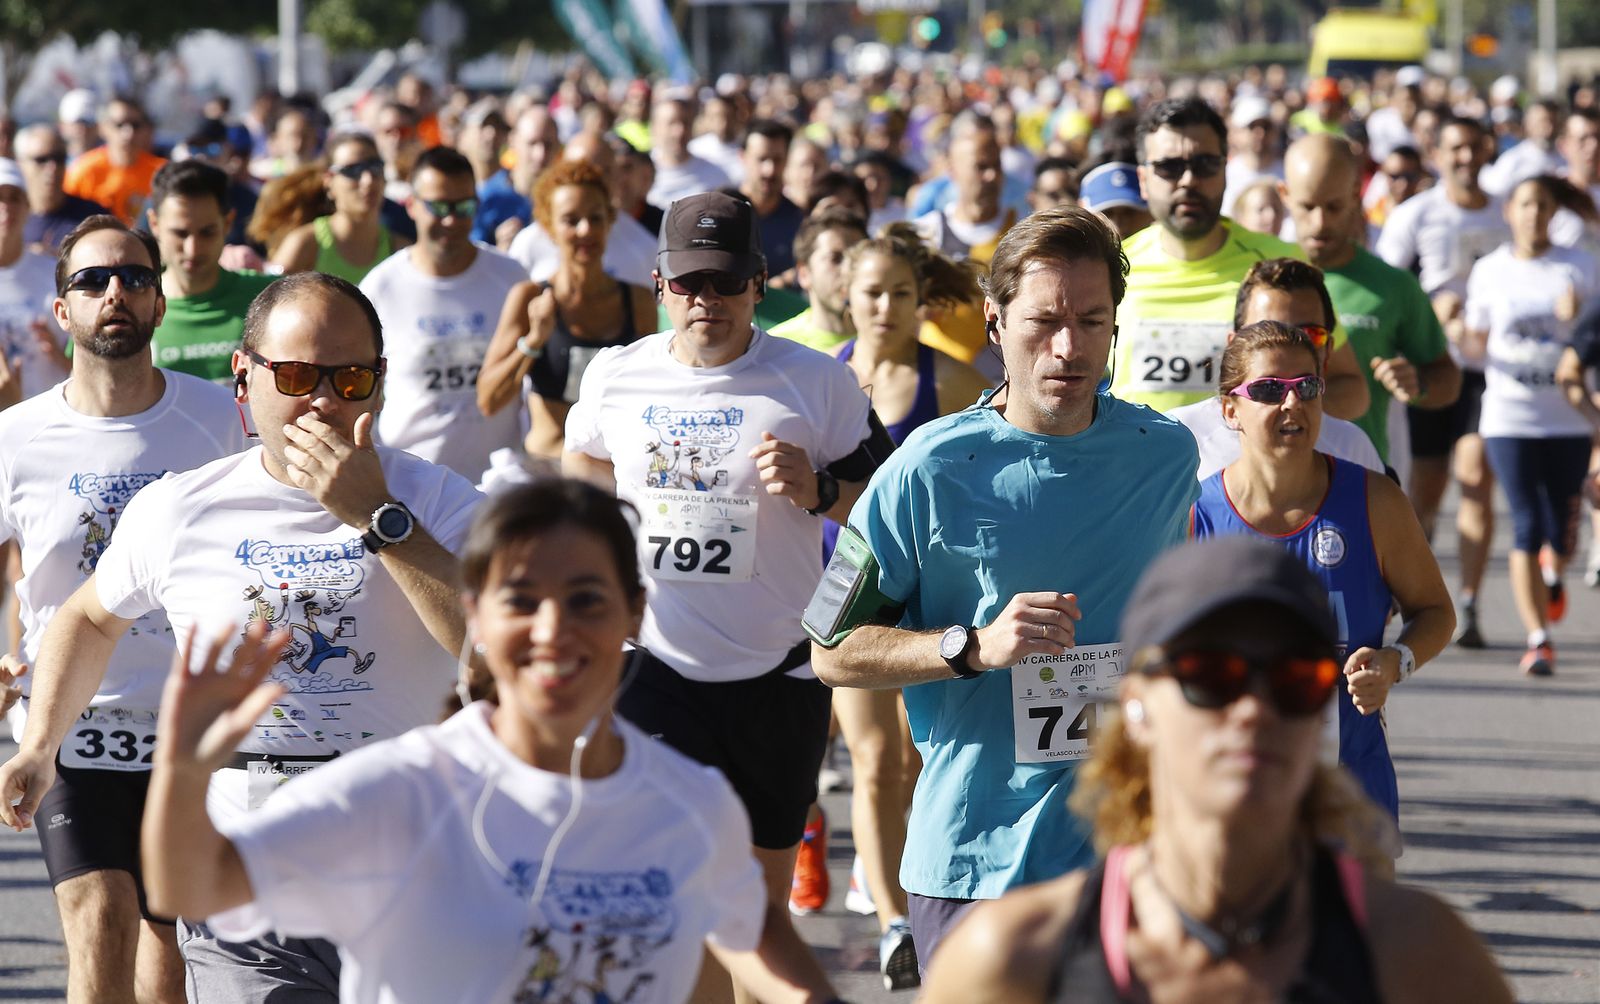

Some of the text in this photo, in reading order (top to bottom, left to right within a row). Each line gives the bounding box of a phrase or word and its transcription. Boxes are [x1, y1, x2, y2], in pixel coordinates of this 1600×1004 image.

[1143, 356, 1213, 383] 291
[653, 409, 726, 424] Carrera
[652, 493, 689, 502] CARRERA
[704, 496, 715, 504] LA
[716, 497, 750, 506] PRENSA
[250, 543, 345, 565] Carrera
[648, 535, 732, 575] 792
[270, 560, 354, 578] Prensa
[1018, 648, 1124, 666] IV CARRERA DE LA PR
[1070, 663, 1096, 677] APM
[1028, 702, 1097, 751] 74
[1045, 750, 1073, 758] VELASCO
[257, 766, 268, 774] IV
